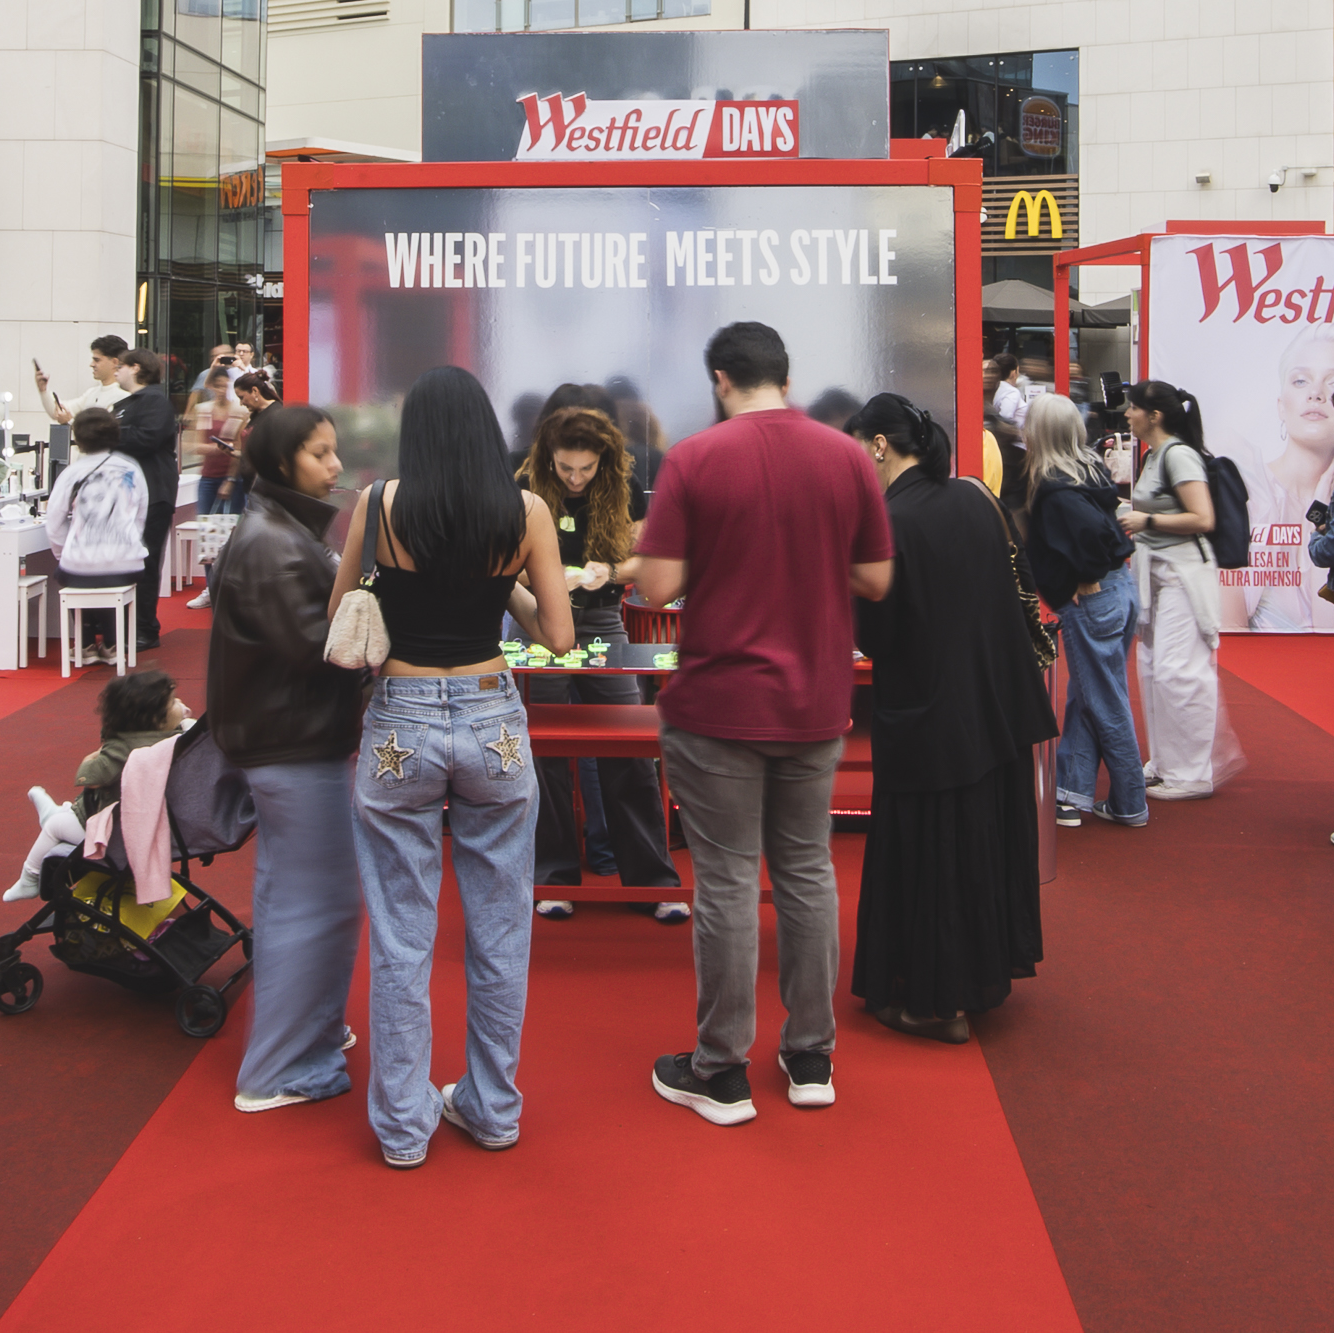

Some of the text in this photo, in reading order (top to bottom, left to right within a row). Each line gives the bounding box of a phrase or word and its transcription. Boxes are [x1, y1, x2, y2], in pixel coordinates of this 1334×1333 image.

[516, 91, 795, 153] Westfield DAYS
[385, 229, 898, 288] WHERE FUTURE MEETS STYLE
[1272, 526, 1301, 544] DAYS
[1248, 551, 1289, 567] LESA EN
[1219, 566, 1302, 586] ALTRA DIMENSIÓ
